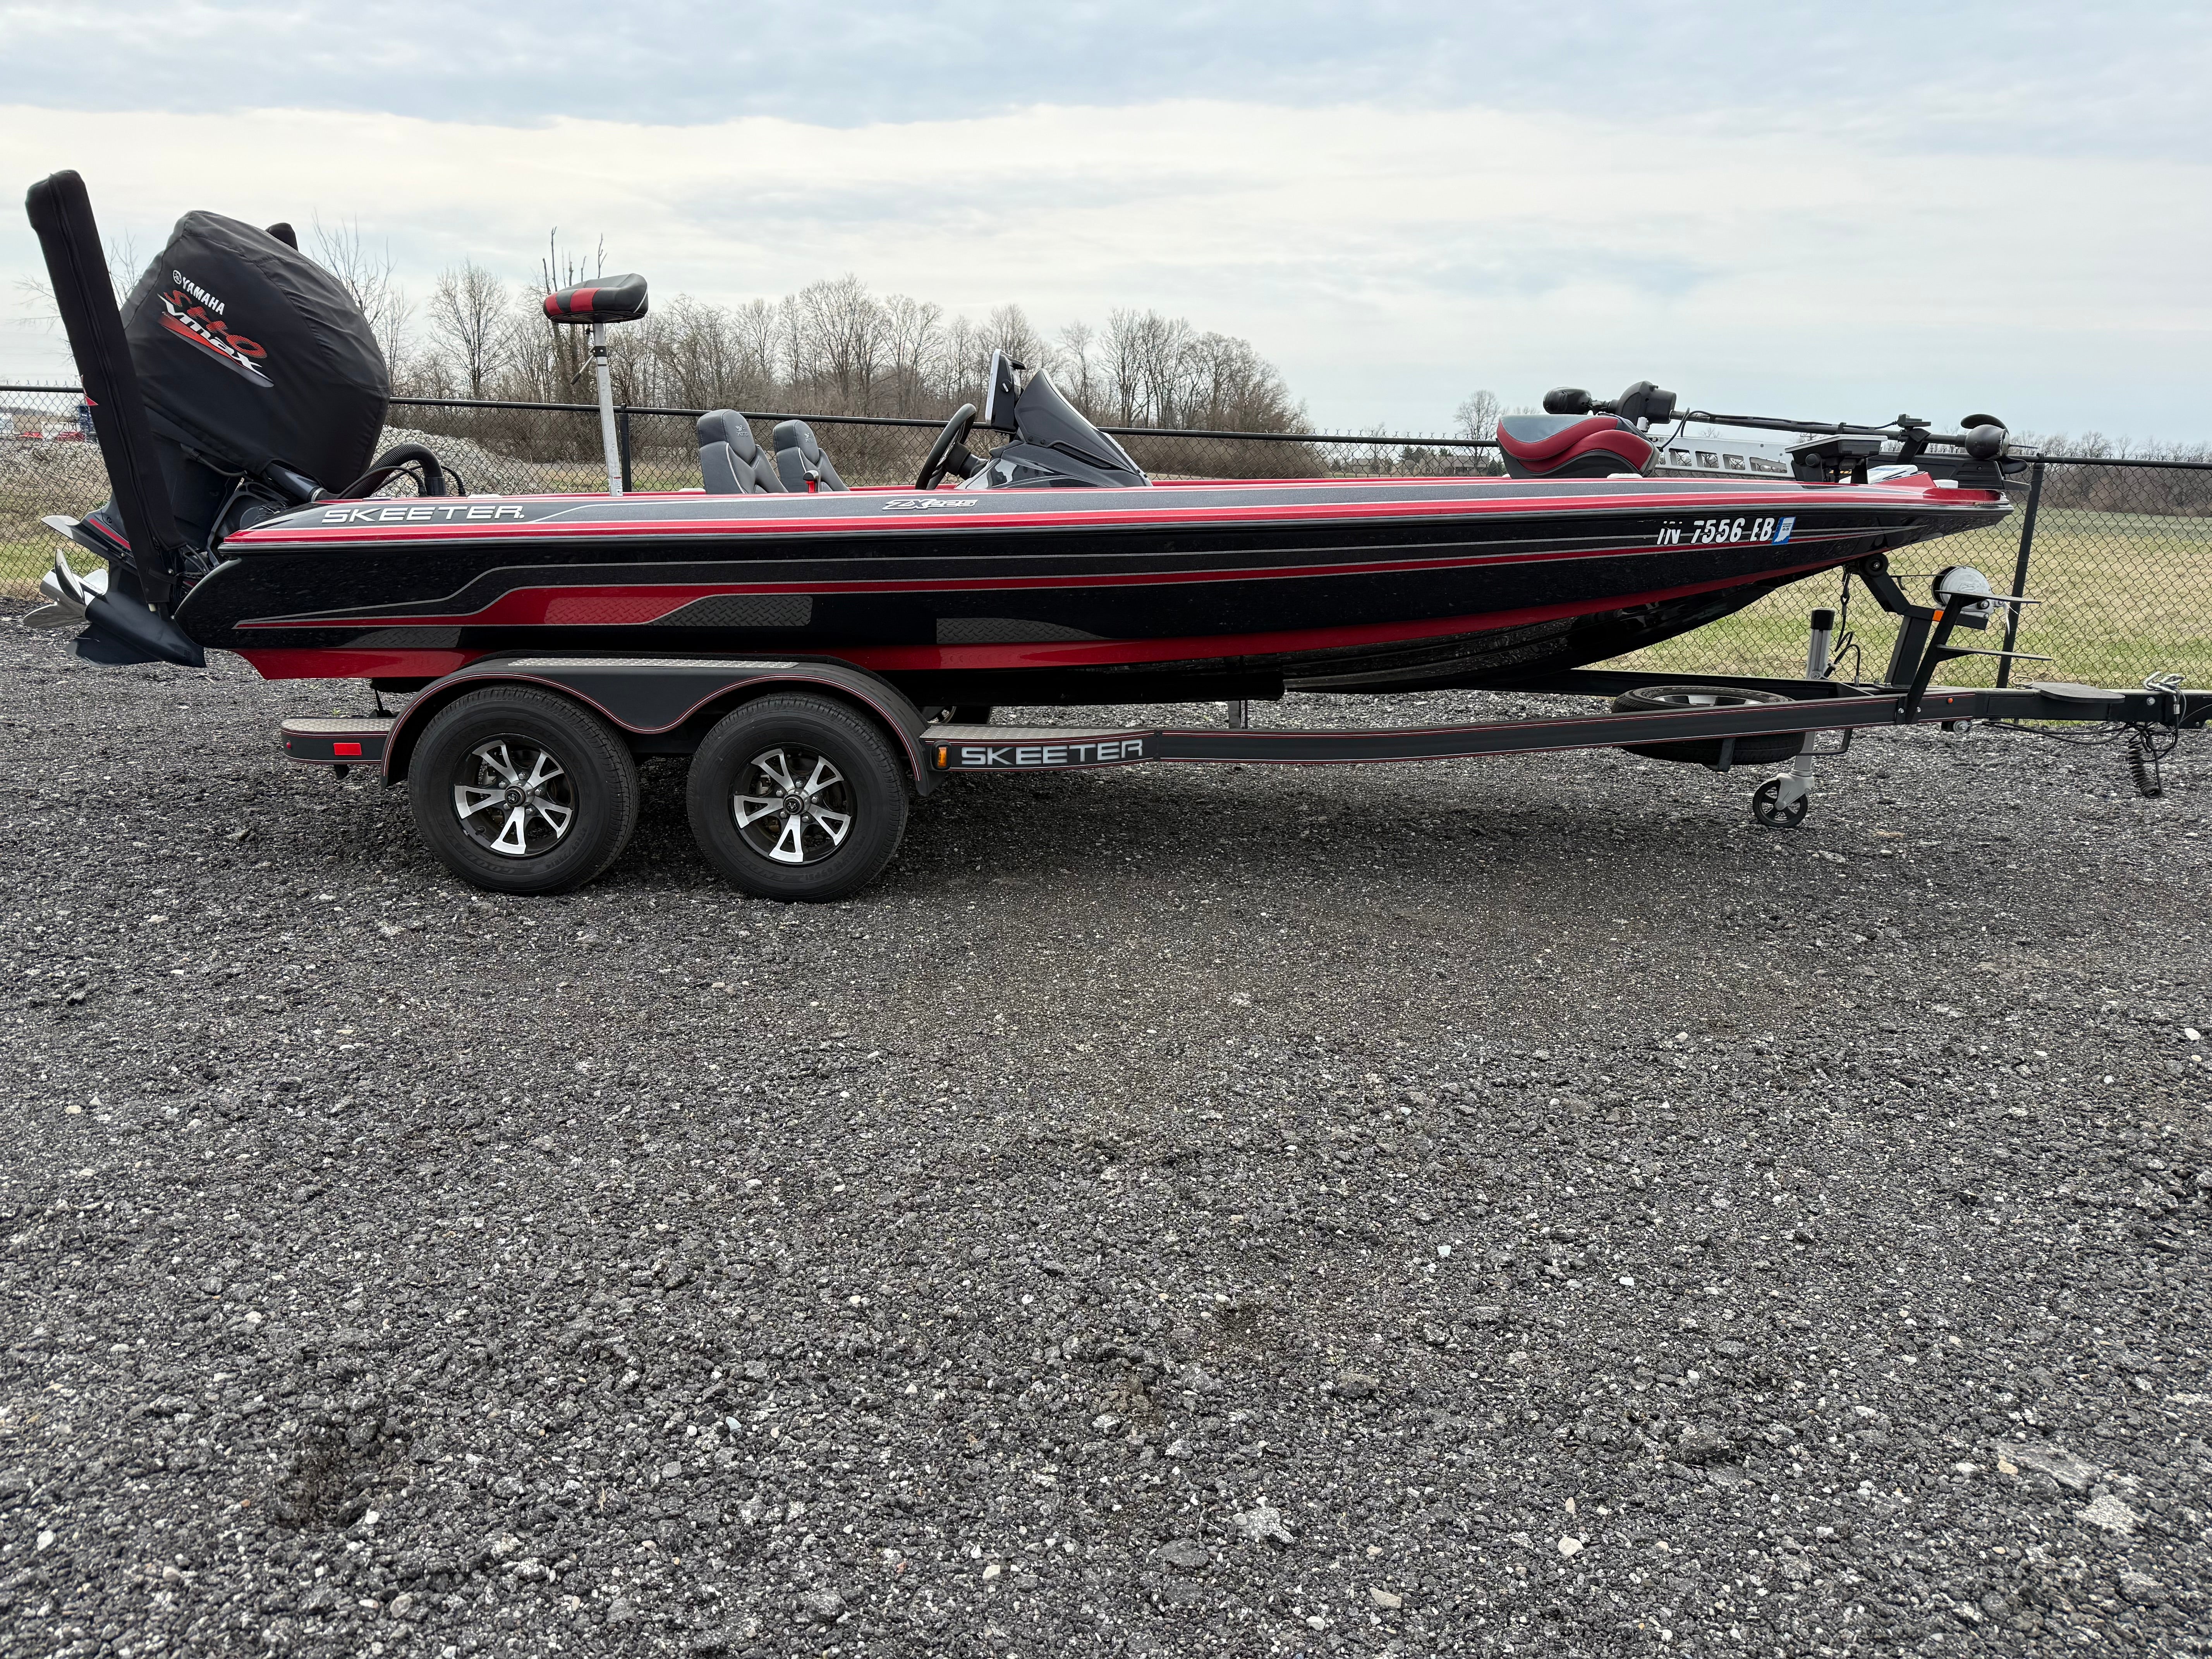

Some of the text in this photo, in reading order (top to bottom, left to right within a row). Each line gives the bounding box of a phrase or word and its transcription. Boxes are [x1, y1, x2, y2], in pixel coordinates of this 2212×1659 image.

[182, 276, 225, 315] YAMAHA
[882, 499, 978, 510] ZX225
[1691, 518, 1745, 544] 7556
[1750, 518, 1775, 542] EB
[962, 739, 1143, 765] SKEETER
